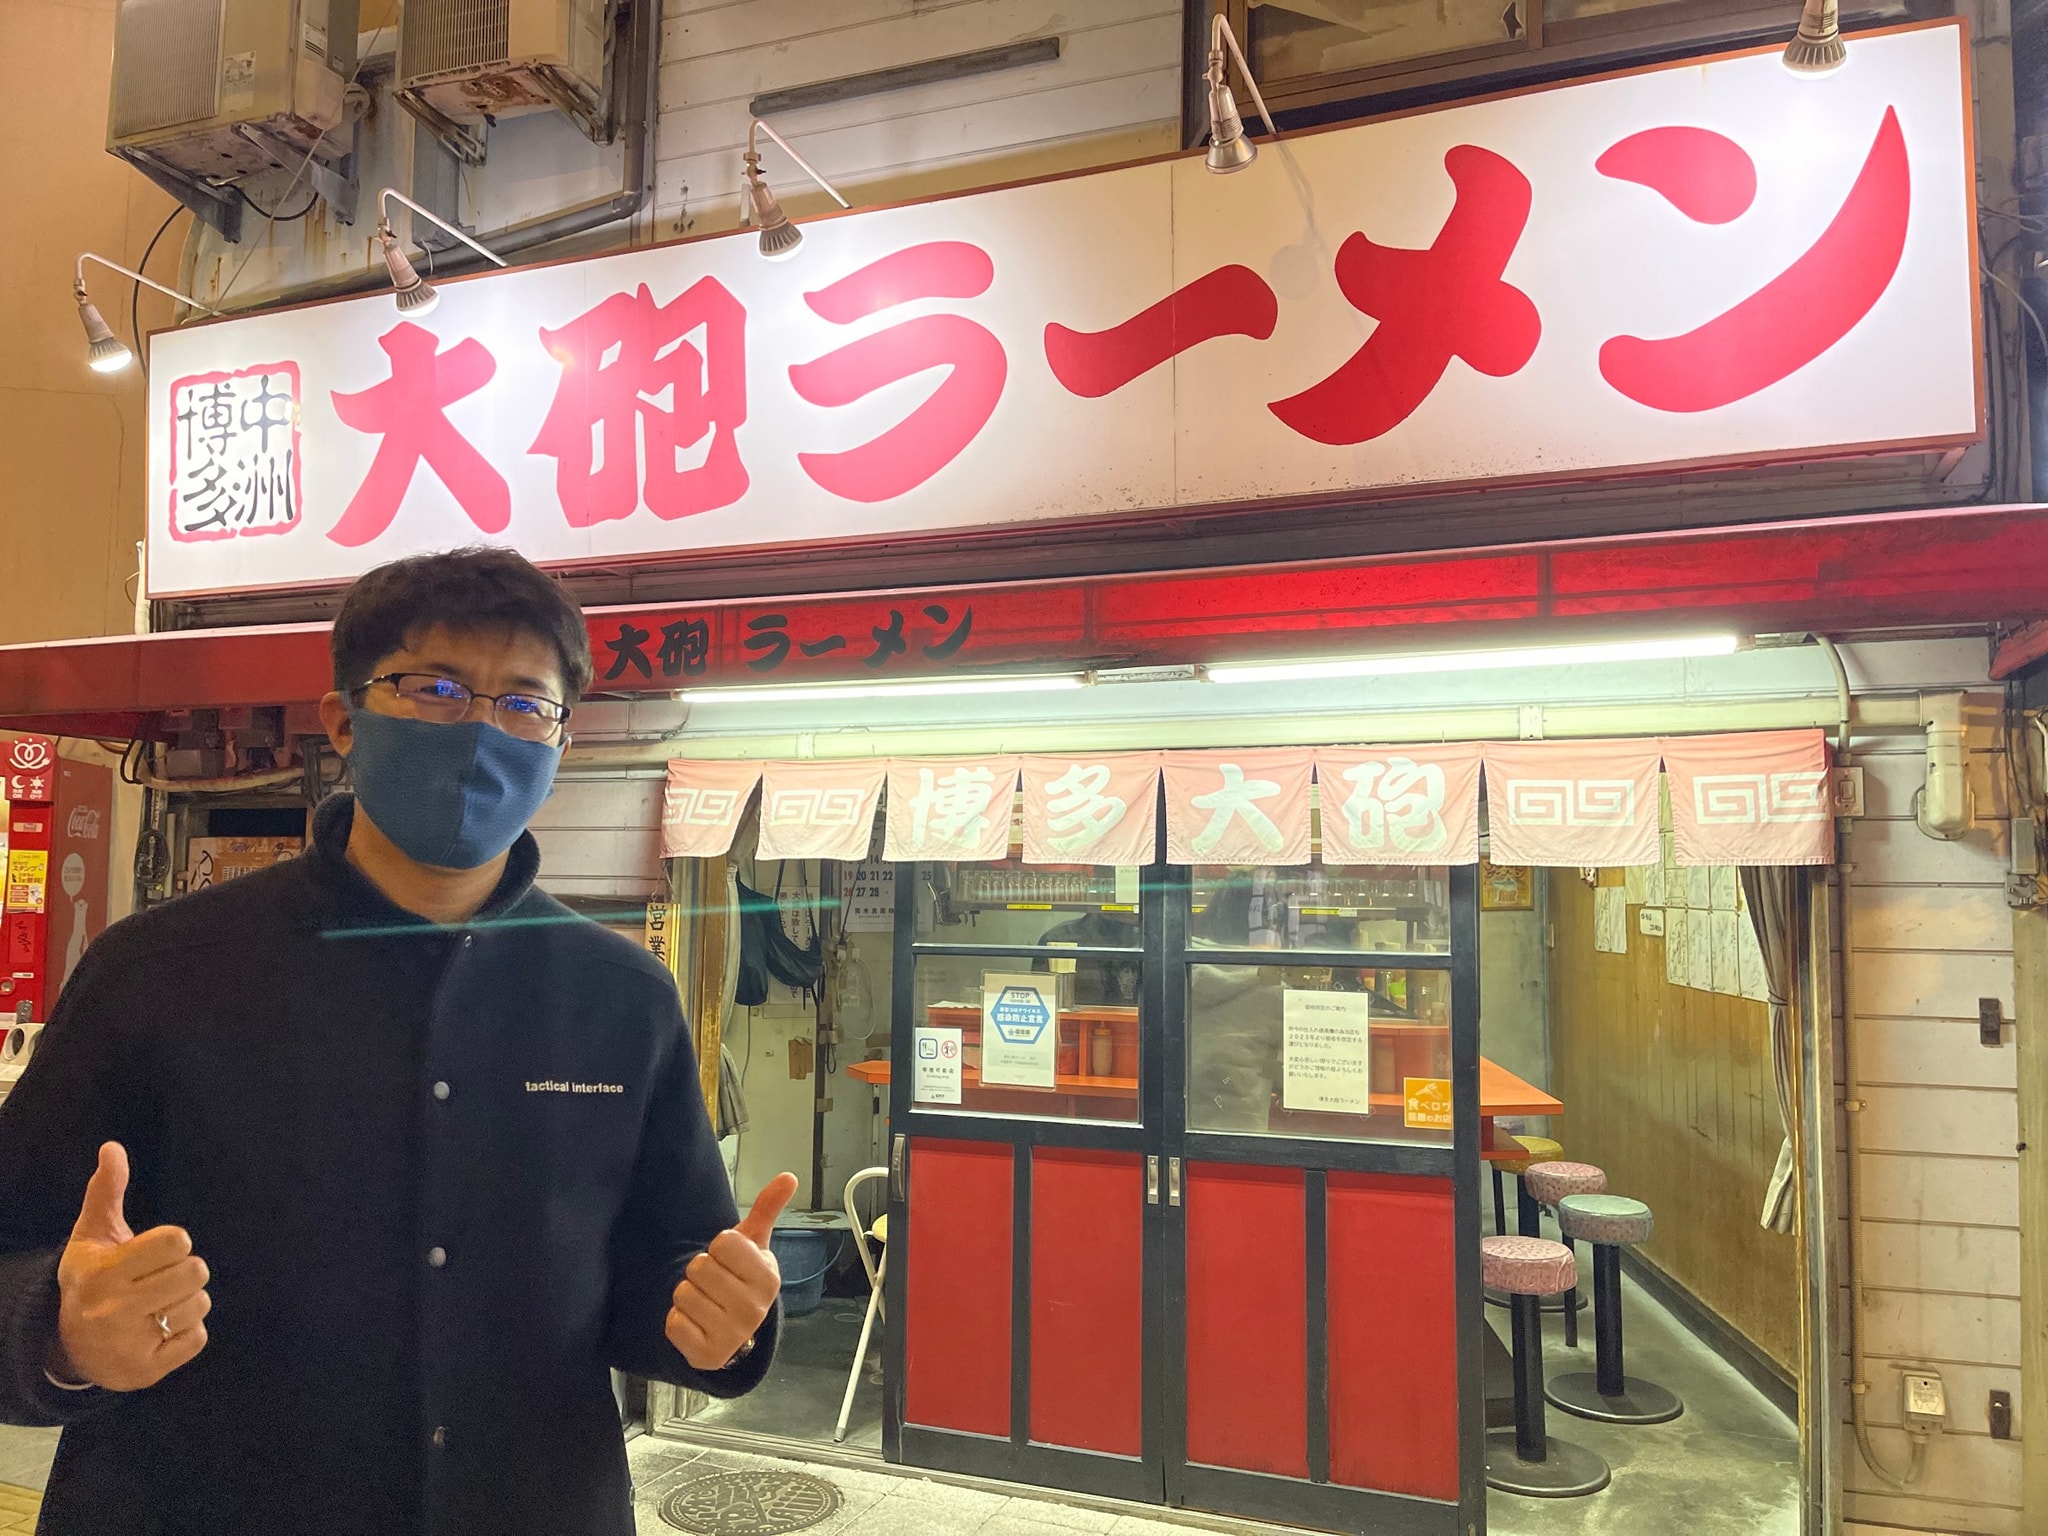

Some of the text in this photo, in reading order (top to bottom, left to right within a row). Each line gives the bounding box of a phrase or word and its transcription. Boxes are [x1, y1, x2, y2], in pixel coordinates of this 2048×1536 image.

[326, 104, 1911, 547] 大砲ラーメン
[870, 855, 879, 864] 14
[844, 871, 931, 880] 19 20 21 22 25
[856, 887, 866, 897] 27
[870, 887, 879, 897] 28
[1011, 991, 1030, 999] STOP
[525, 1080, 624, 1093] tactical interface
